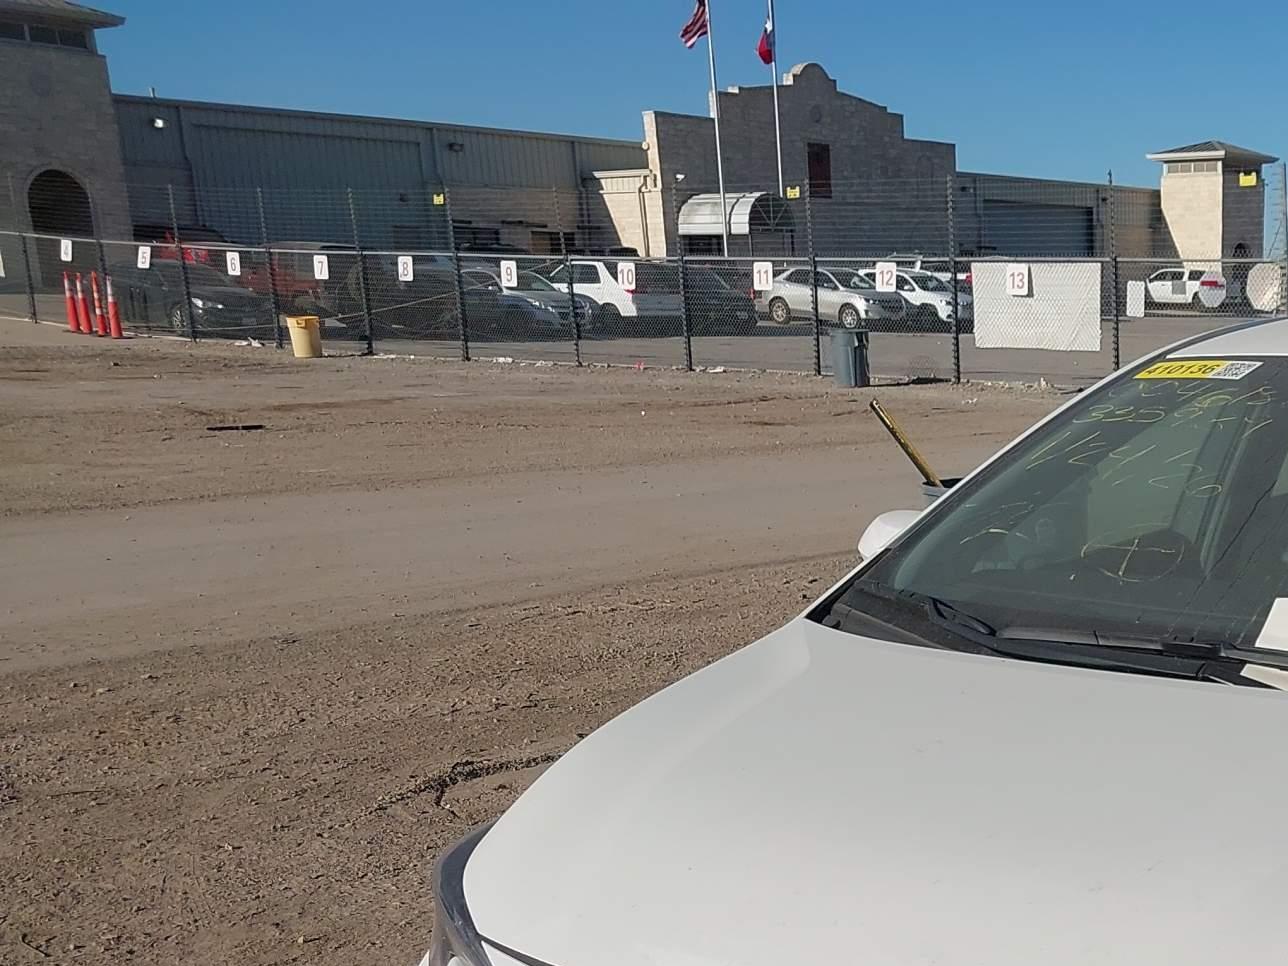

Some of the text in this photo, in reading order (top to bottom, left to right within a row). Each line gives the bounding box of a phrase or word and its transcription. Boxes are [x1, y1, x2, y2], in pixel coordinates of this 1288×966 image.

[141, 251, 147, 264] 5
[230, 258, 237, 271] 6
[317, 260, 324, 275] 7
[402, 261, 409, 277] 8
[505, 266, 513, 282] 9
[619, 268, 634, 285] 10
[756, 269, 770, 285] 11
[878, 270, 894, 286] 12
[1009, 272, 1025, 289] 13
[1146, 363, 1221, 375] 410136
